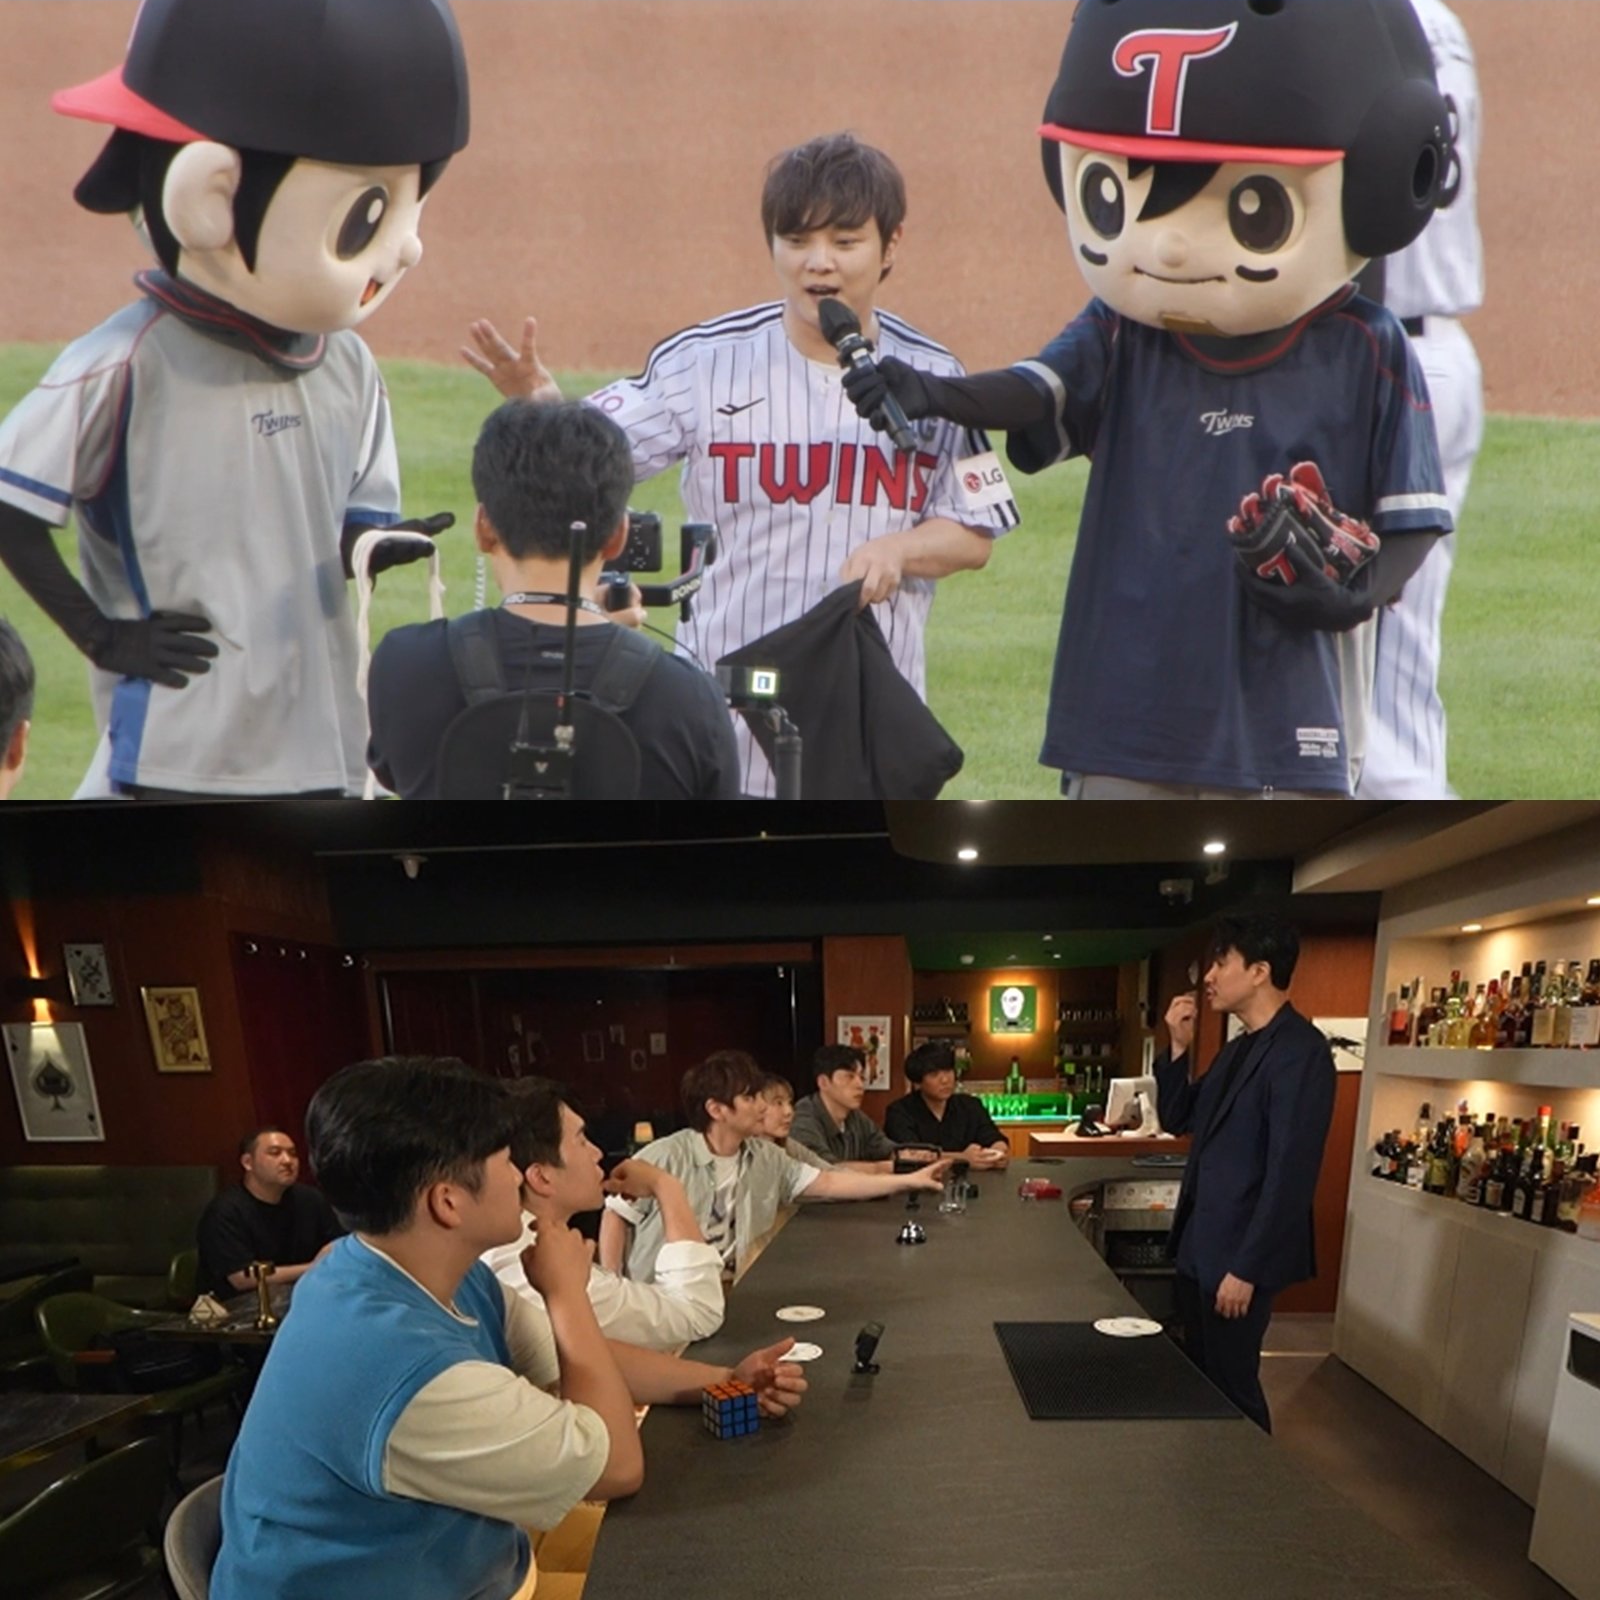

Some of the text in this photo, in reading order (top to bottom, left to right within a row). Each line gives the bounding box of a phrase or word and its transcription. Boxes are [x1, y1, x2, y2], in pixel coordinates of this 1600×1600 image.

[1112, 20, 1239, 136] T
[708, 442, 939, 513] TWINS
[981, 467, 1004, 486] LG
